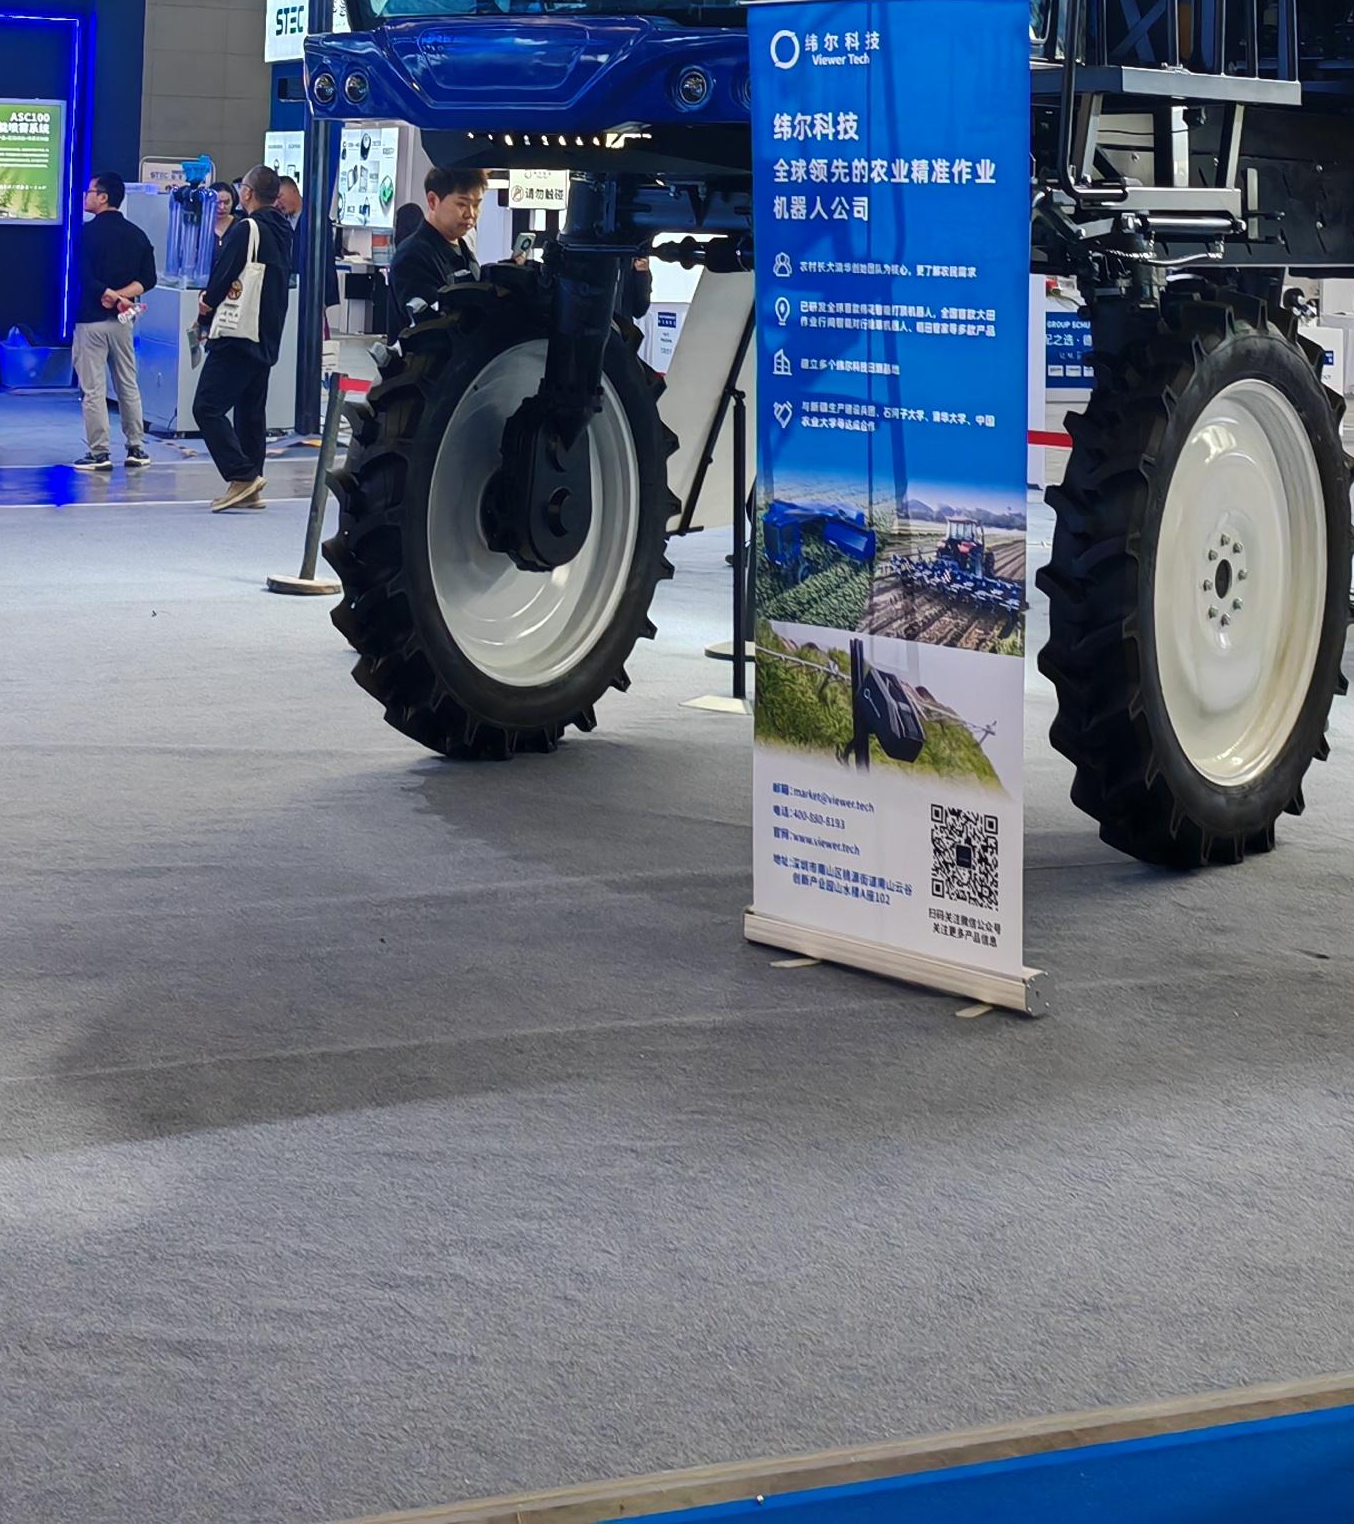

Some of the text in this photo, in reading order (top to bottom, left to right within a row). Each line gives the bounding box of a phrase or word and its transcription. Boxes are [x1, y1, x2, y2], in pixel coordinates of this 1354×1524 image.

[276, 4, 305, 36] STEC
[804, 30, 880, 53] 纬尔科技
[811, 52, 870, 66] Viewer Tech
[10, 112, 51, 123] ASC100
[772, 111, 860, 141] 纬尔科技
[772, 157, 997, 185] 全球领先的农业精准作业
[525, 187, 565, 201] 请勿触碰
[772, 195, 869, 221] 机器人公司
